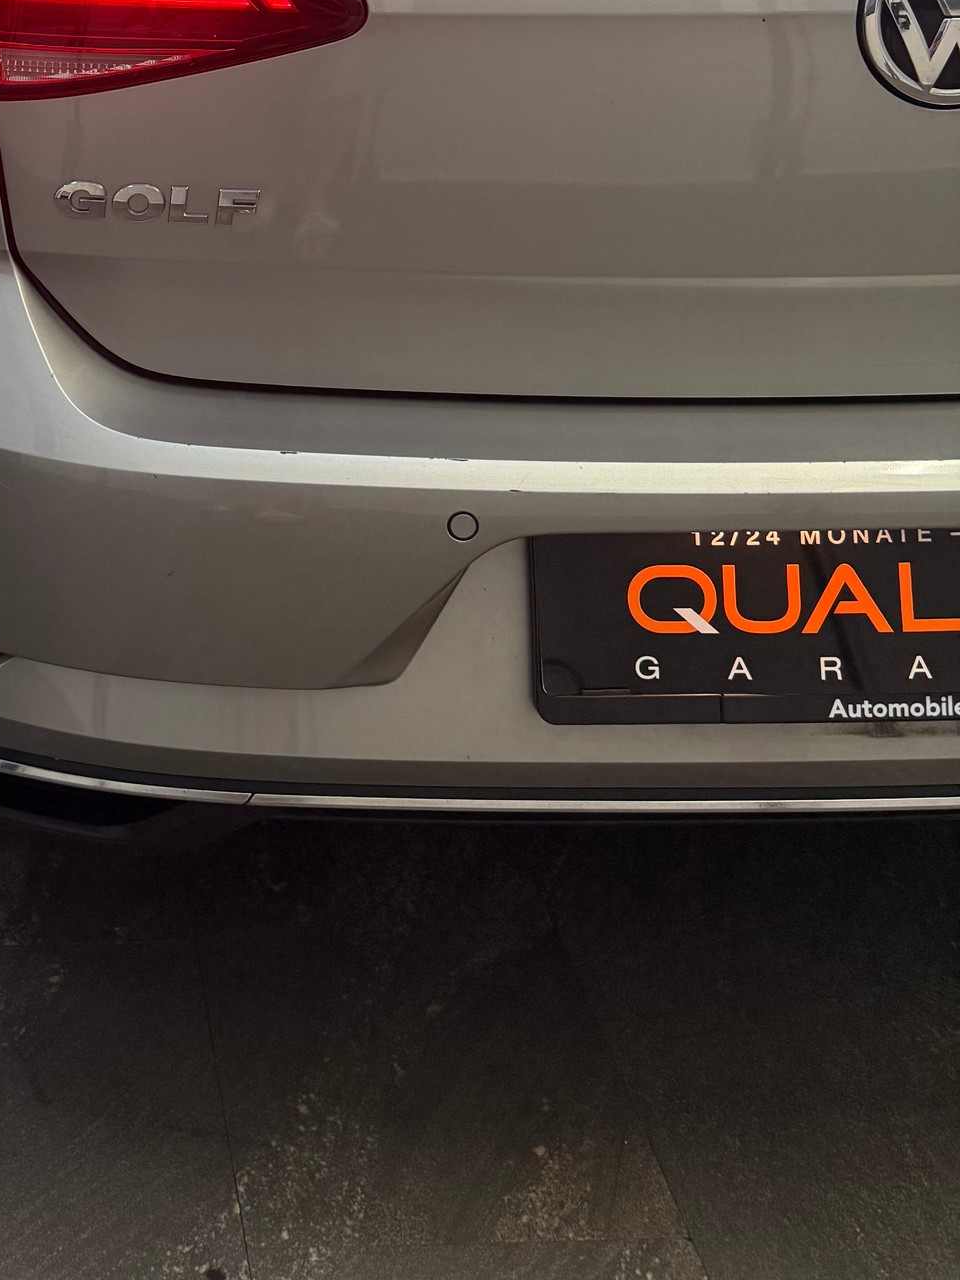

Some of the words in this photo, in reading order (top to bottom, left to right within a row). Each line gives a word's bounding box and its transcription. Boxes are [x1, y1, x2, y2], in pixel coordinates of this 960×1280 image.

[53, 179, 260, 225] GOLF
[691, 530, 780, 546] 12/24
[627, 562, 960, 634] QUAL
[635, 655, 933, 680] GARA
